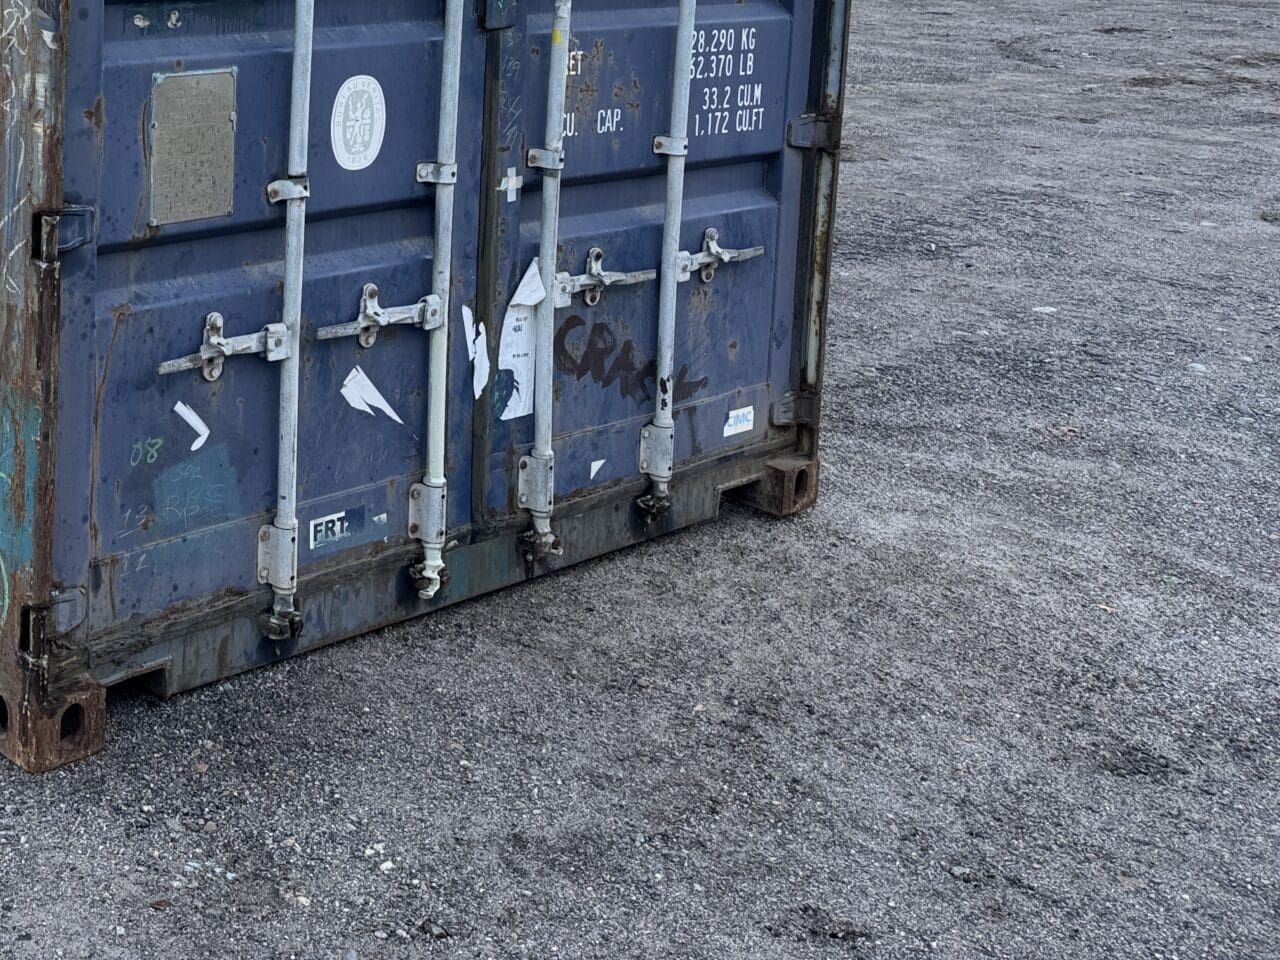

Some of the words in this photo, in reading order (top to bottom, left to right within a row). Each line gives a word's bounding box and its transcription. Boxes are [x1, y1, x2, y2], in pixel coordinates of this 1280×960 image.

[691, 28, 735, 53] 28,290
[741, 28, 756, 50] KG
[739, 53, 754, 75] LB
[702, 86, 731, 109] 33.2
[737, 83, 762, 107] CU.M
[596, 108, 624, 134] CAP.
[695, 111, 730, 136] 1,172
[736, 108, 764, 132] CU.FT
